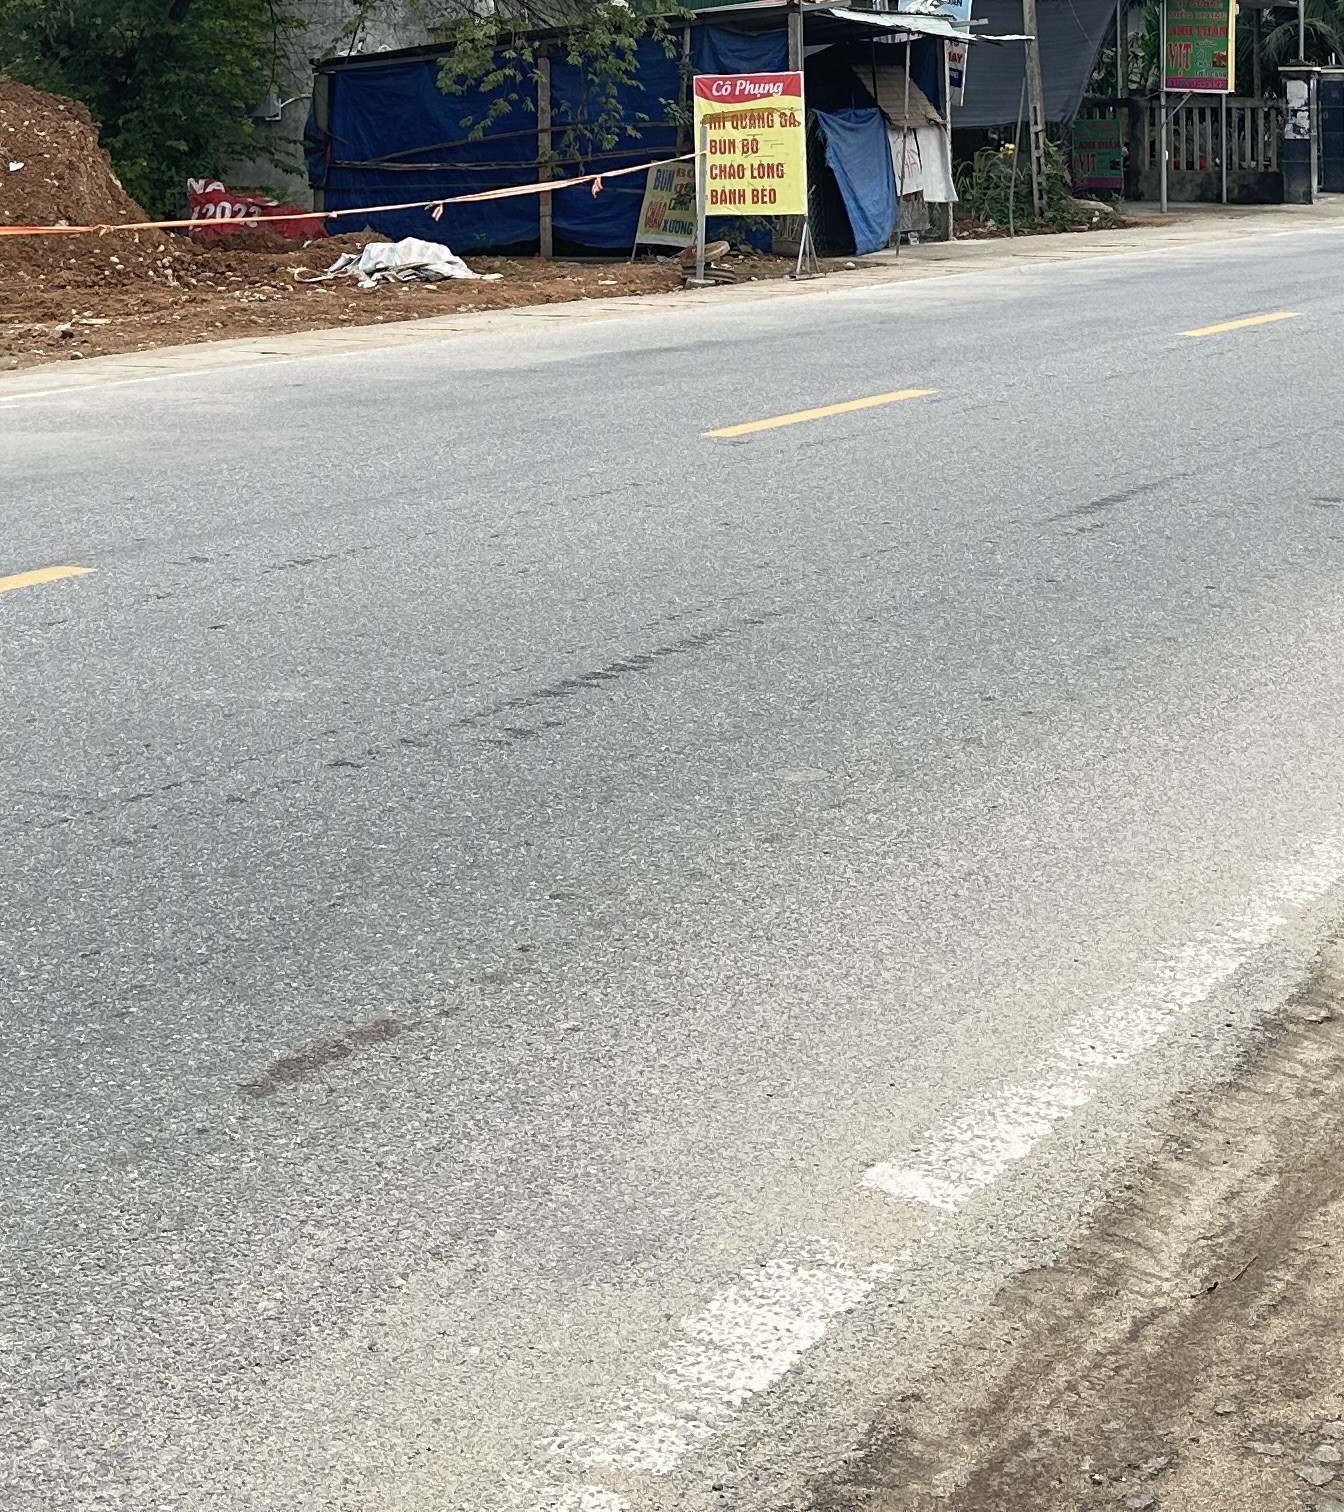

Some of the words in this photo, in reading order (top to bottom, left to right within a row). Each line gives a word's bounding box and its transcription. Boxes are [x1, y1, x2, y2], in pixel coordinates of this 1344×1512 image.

[1167, 41, 1193, 77] VỊT
[712, 80, 731, 96] Cô
[736, 79, 783, 97] Phụng
[709, 160, 745, 180] CHÁO
[750, 160, 785, 179] LÒNG
[710, 185, 746, 205] BÁNH
[751, 184, 777, 205] BÈO
